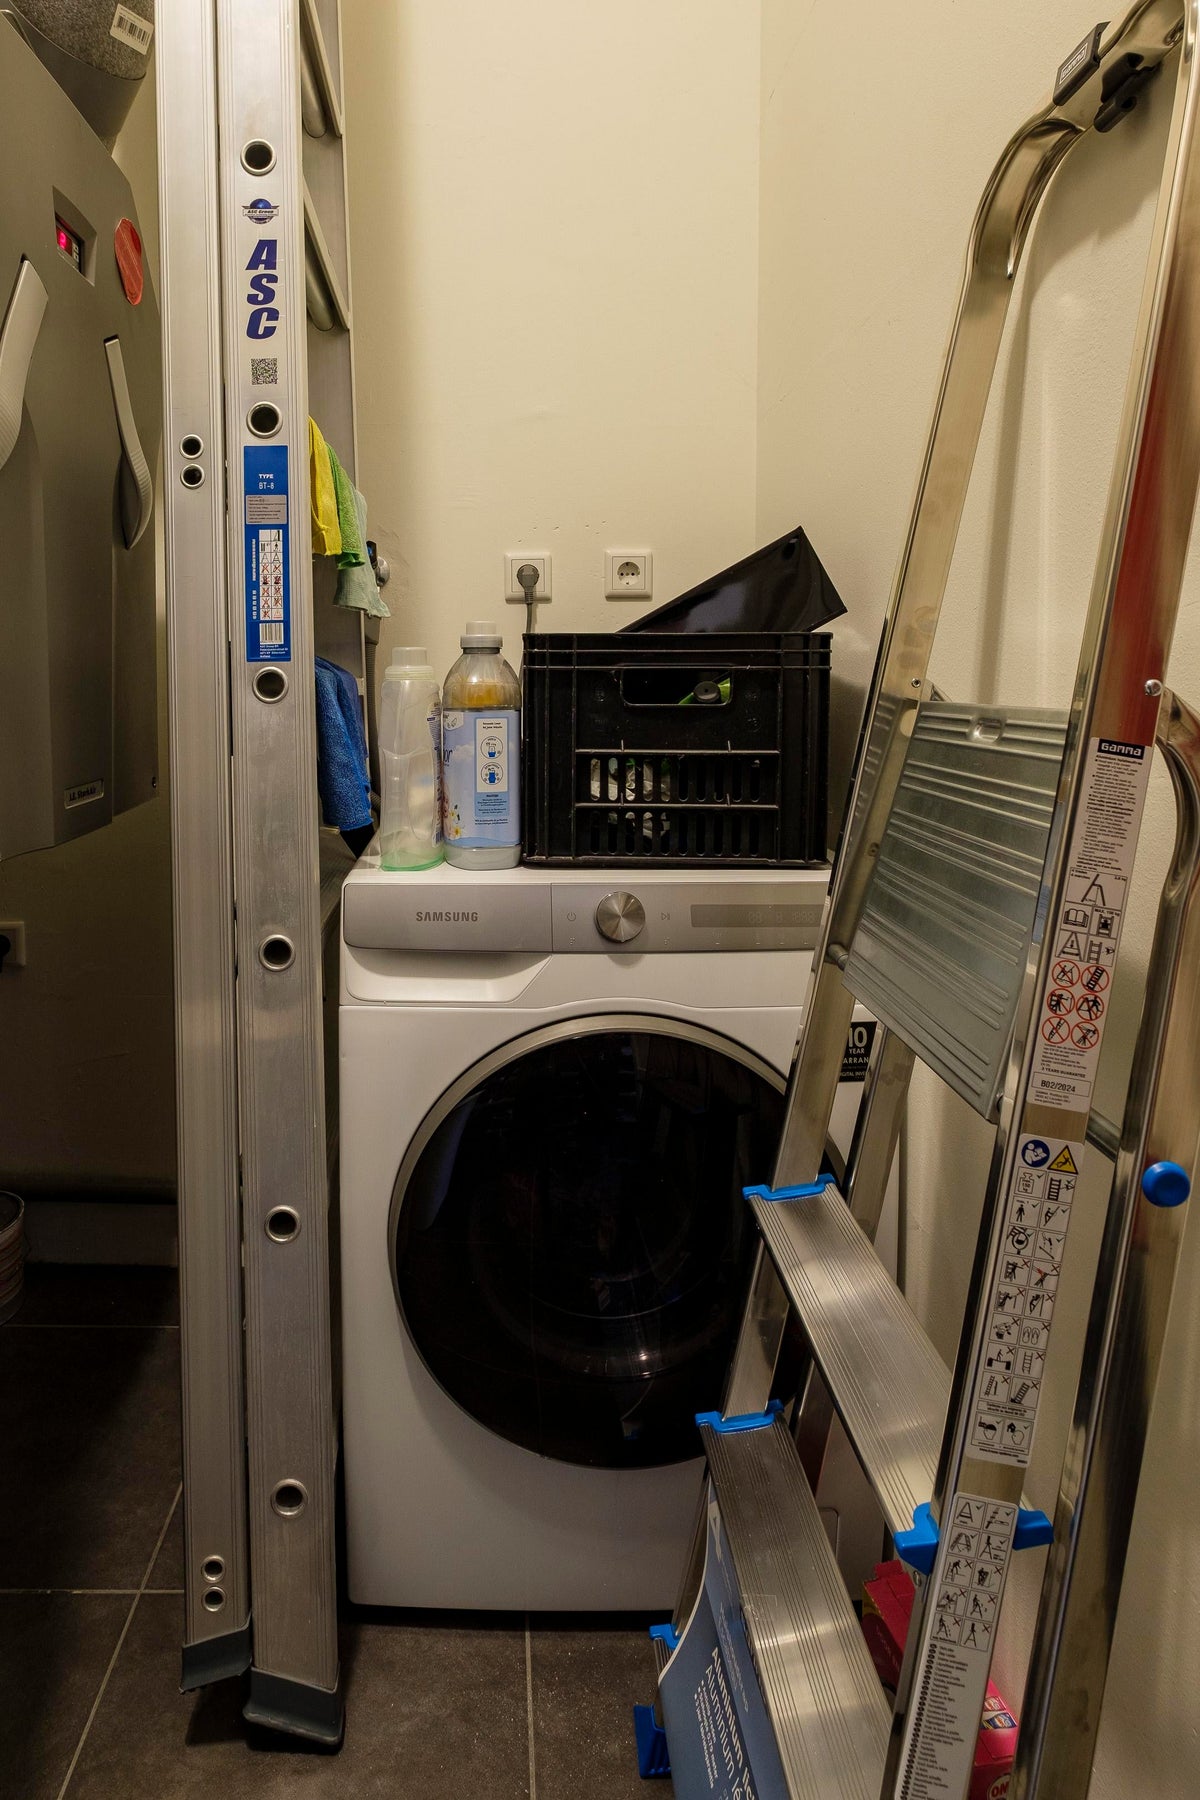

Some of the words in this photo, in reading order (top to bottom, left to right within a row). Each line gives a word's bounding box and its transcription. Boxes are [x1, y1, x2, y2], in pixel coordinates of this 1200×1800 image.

[245, 239, 280, 340] ASC
[416, 911, 479, 922] SAMSUNG
[849, 1027, 868, 1048] 10
[1041, 1079, 1076, 1092] B02/2024
[706, 1664, 735, 1780] Aluminium
[712, 1647, 743, 1769] Aluminium
